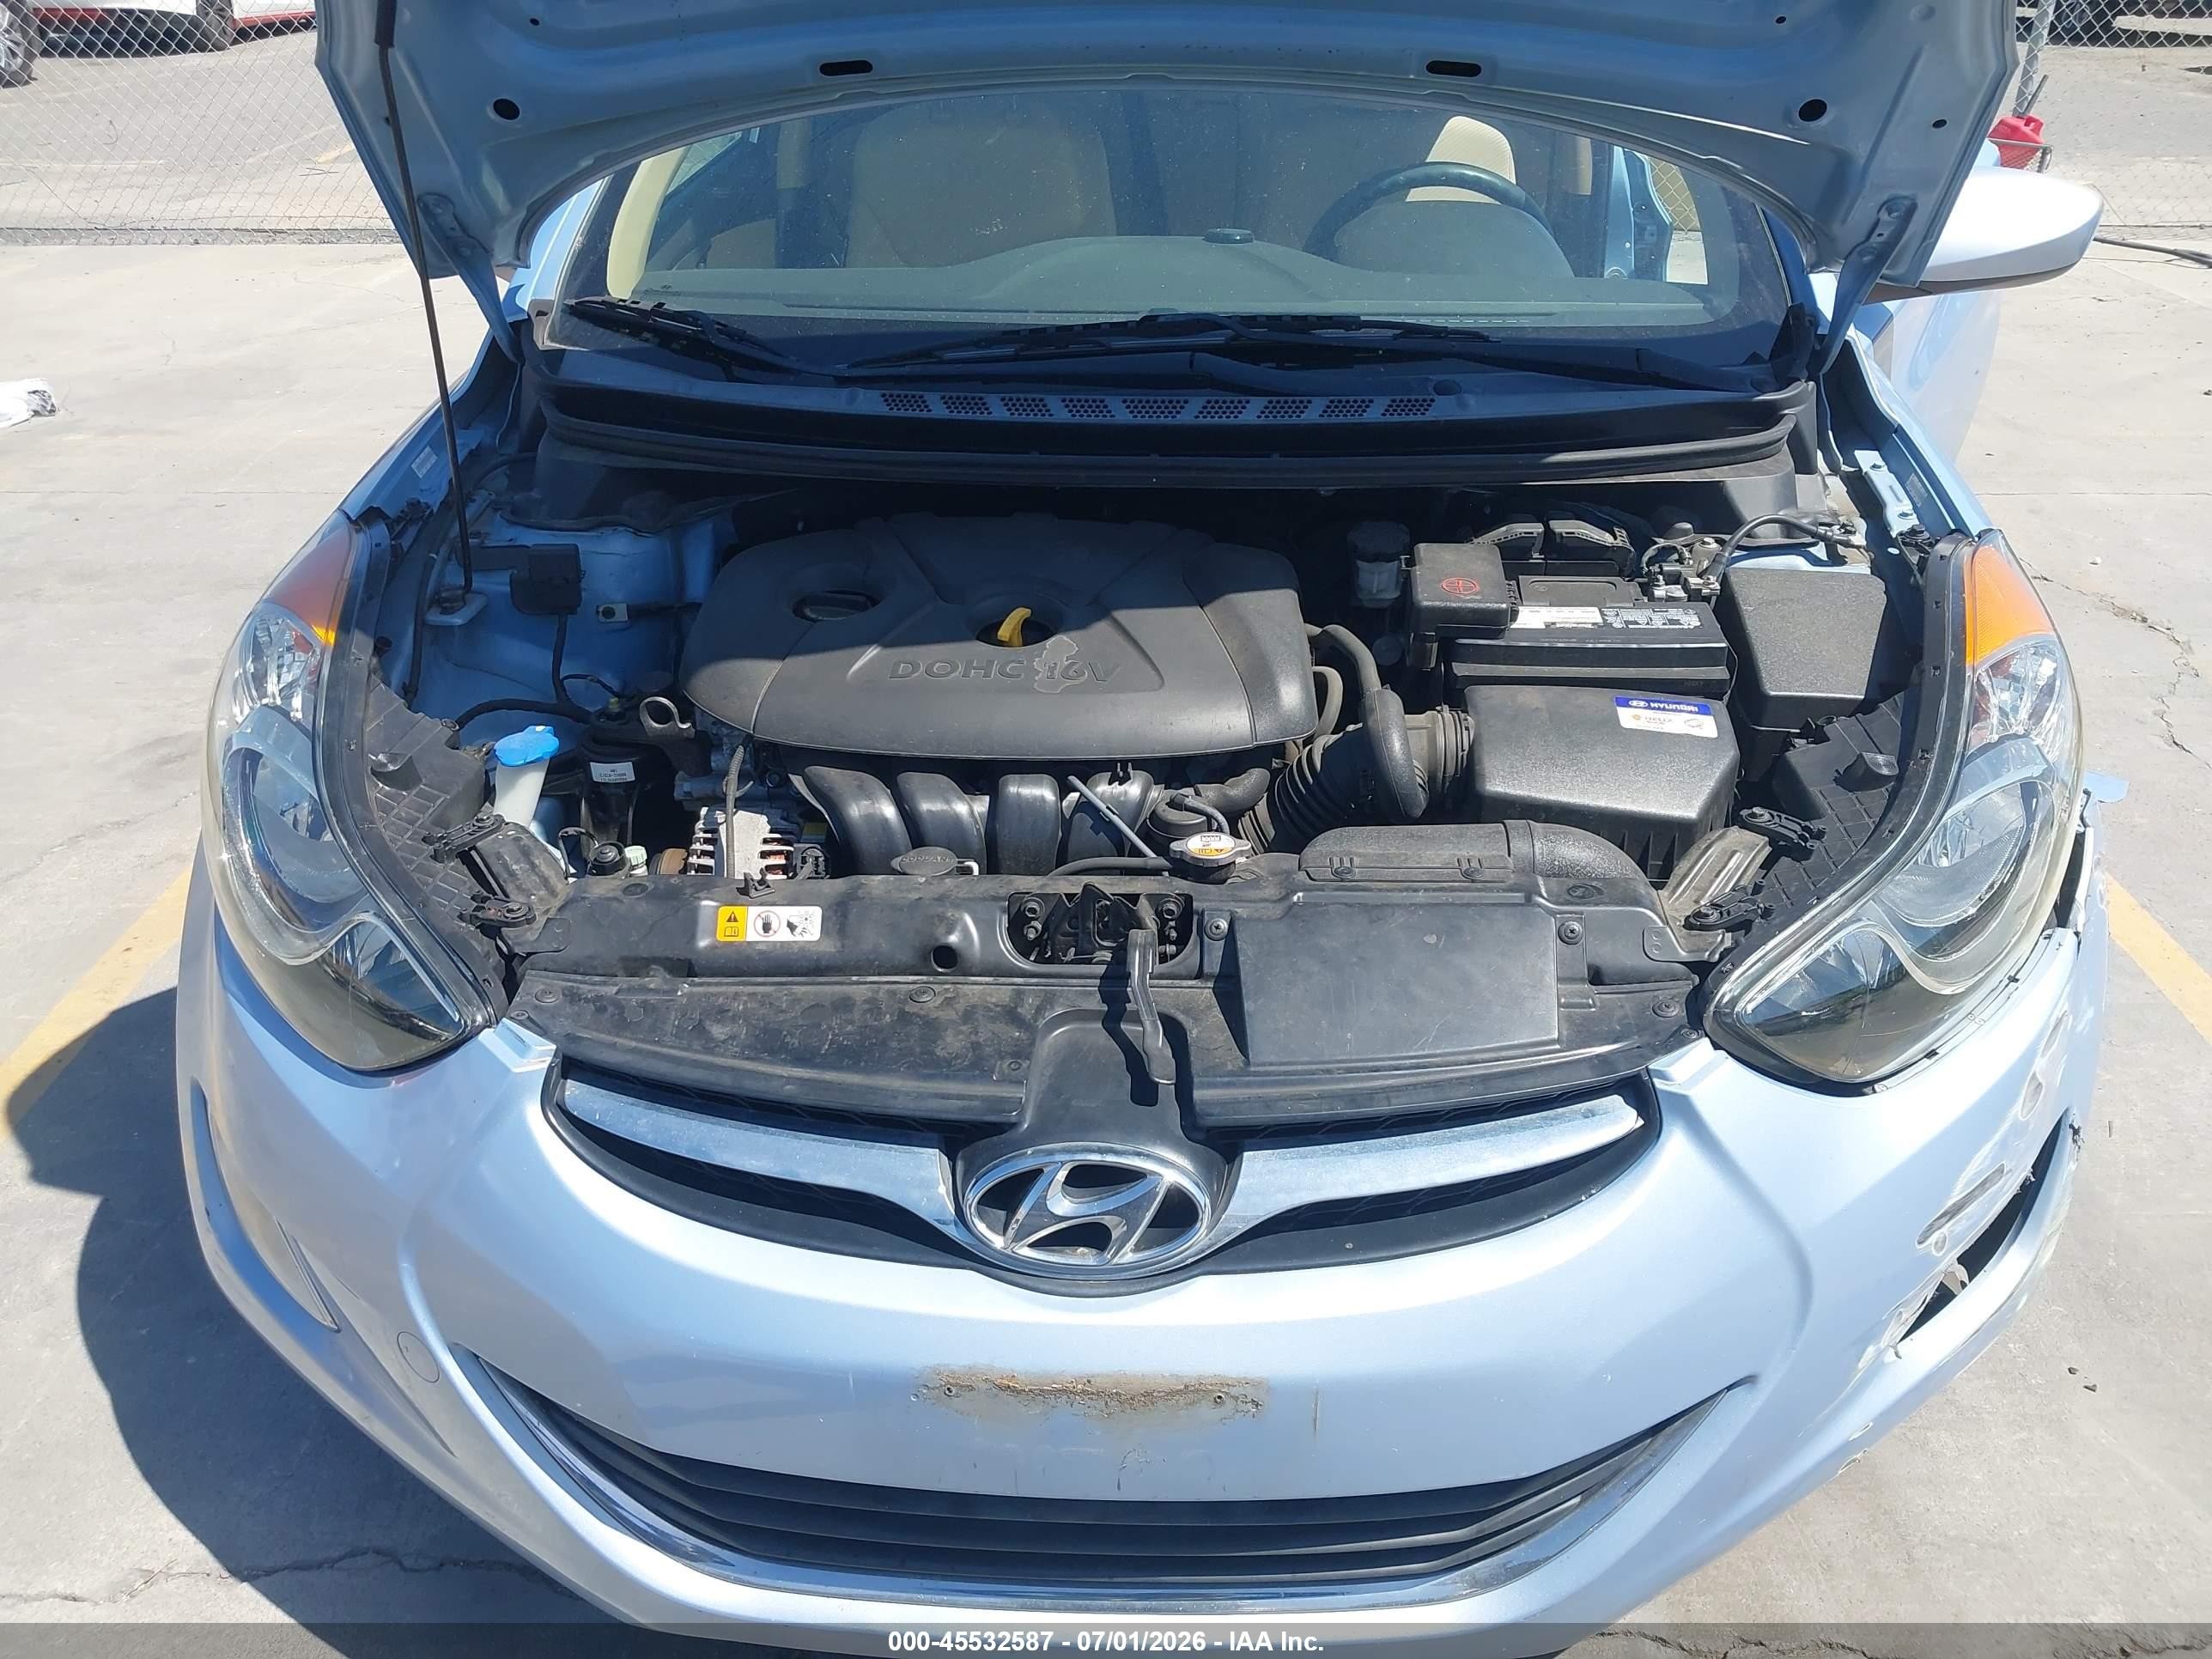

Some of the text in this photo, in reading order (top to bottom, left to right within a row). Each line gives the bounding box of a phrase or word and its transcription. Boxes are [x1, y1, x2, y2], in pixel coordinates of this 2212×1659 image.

[888, 659, 1121, 683] DOHC 16V
[1650, 702, 1699, 713] HYUNDAI
